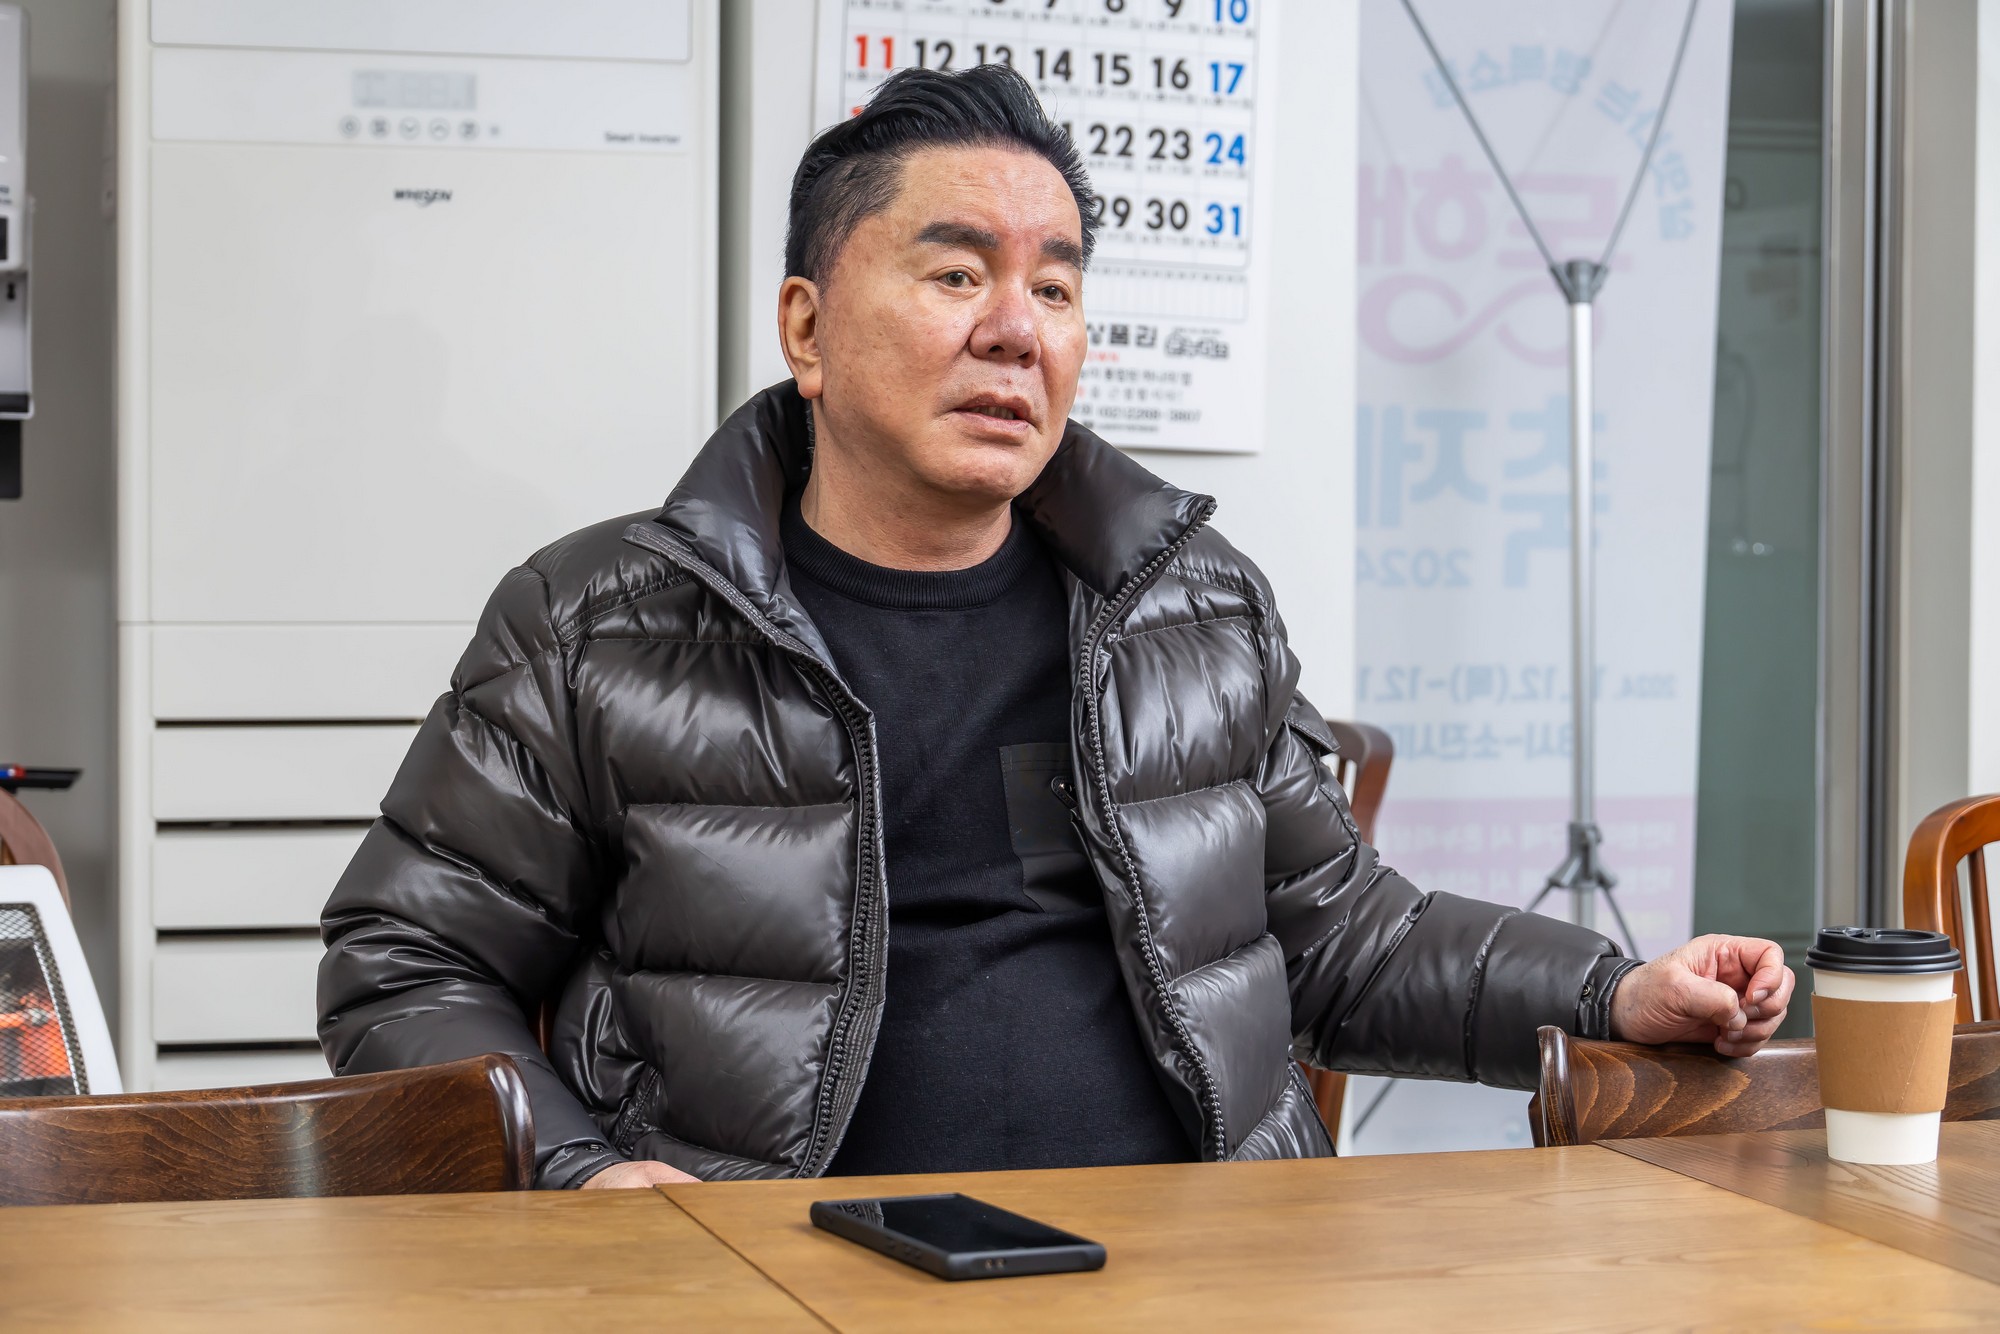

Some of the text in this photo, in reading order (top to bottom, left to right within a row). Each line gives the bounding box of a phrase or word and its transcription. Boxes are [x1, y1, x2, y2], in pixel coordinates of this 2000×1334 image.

[1213, 0, 1248, 23] 10
[855, 35, 1245, 95] 11 12 13 14 15 16 17
[1089, 123, 1134, 158] 22
[1148, 127, 1192, 161] 23
[1205, 132, 1246, 167] 24
[1095, 194, 1241, 237] 29 30 31
